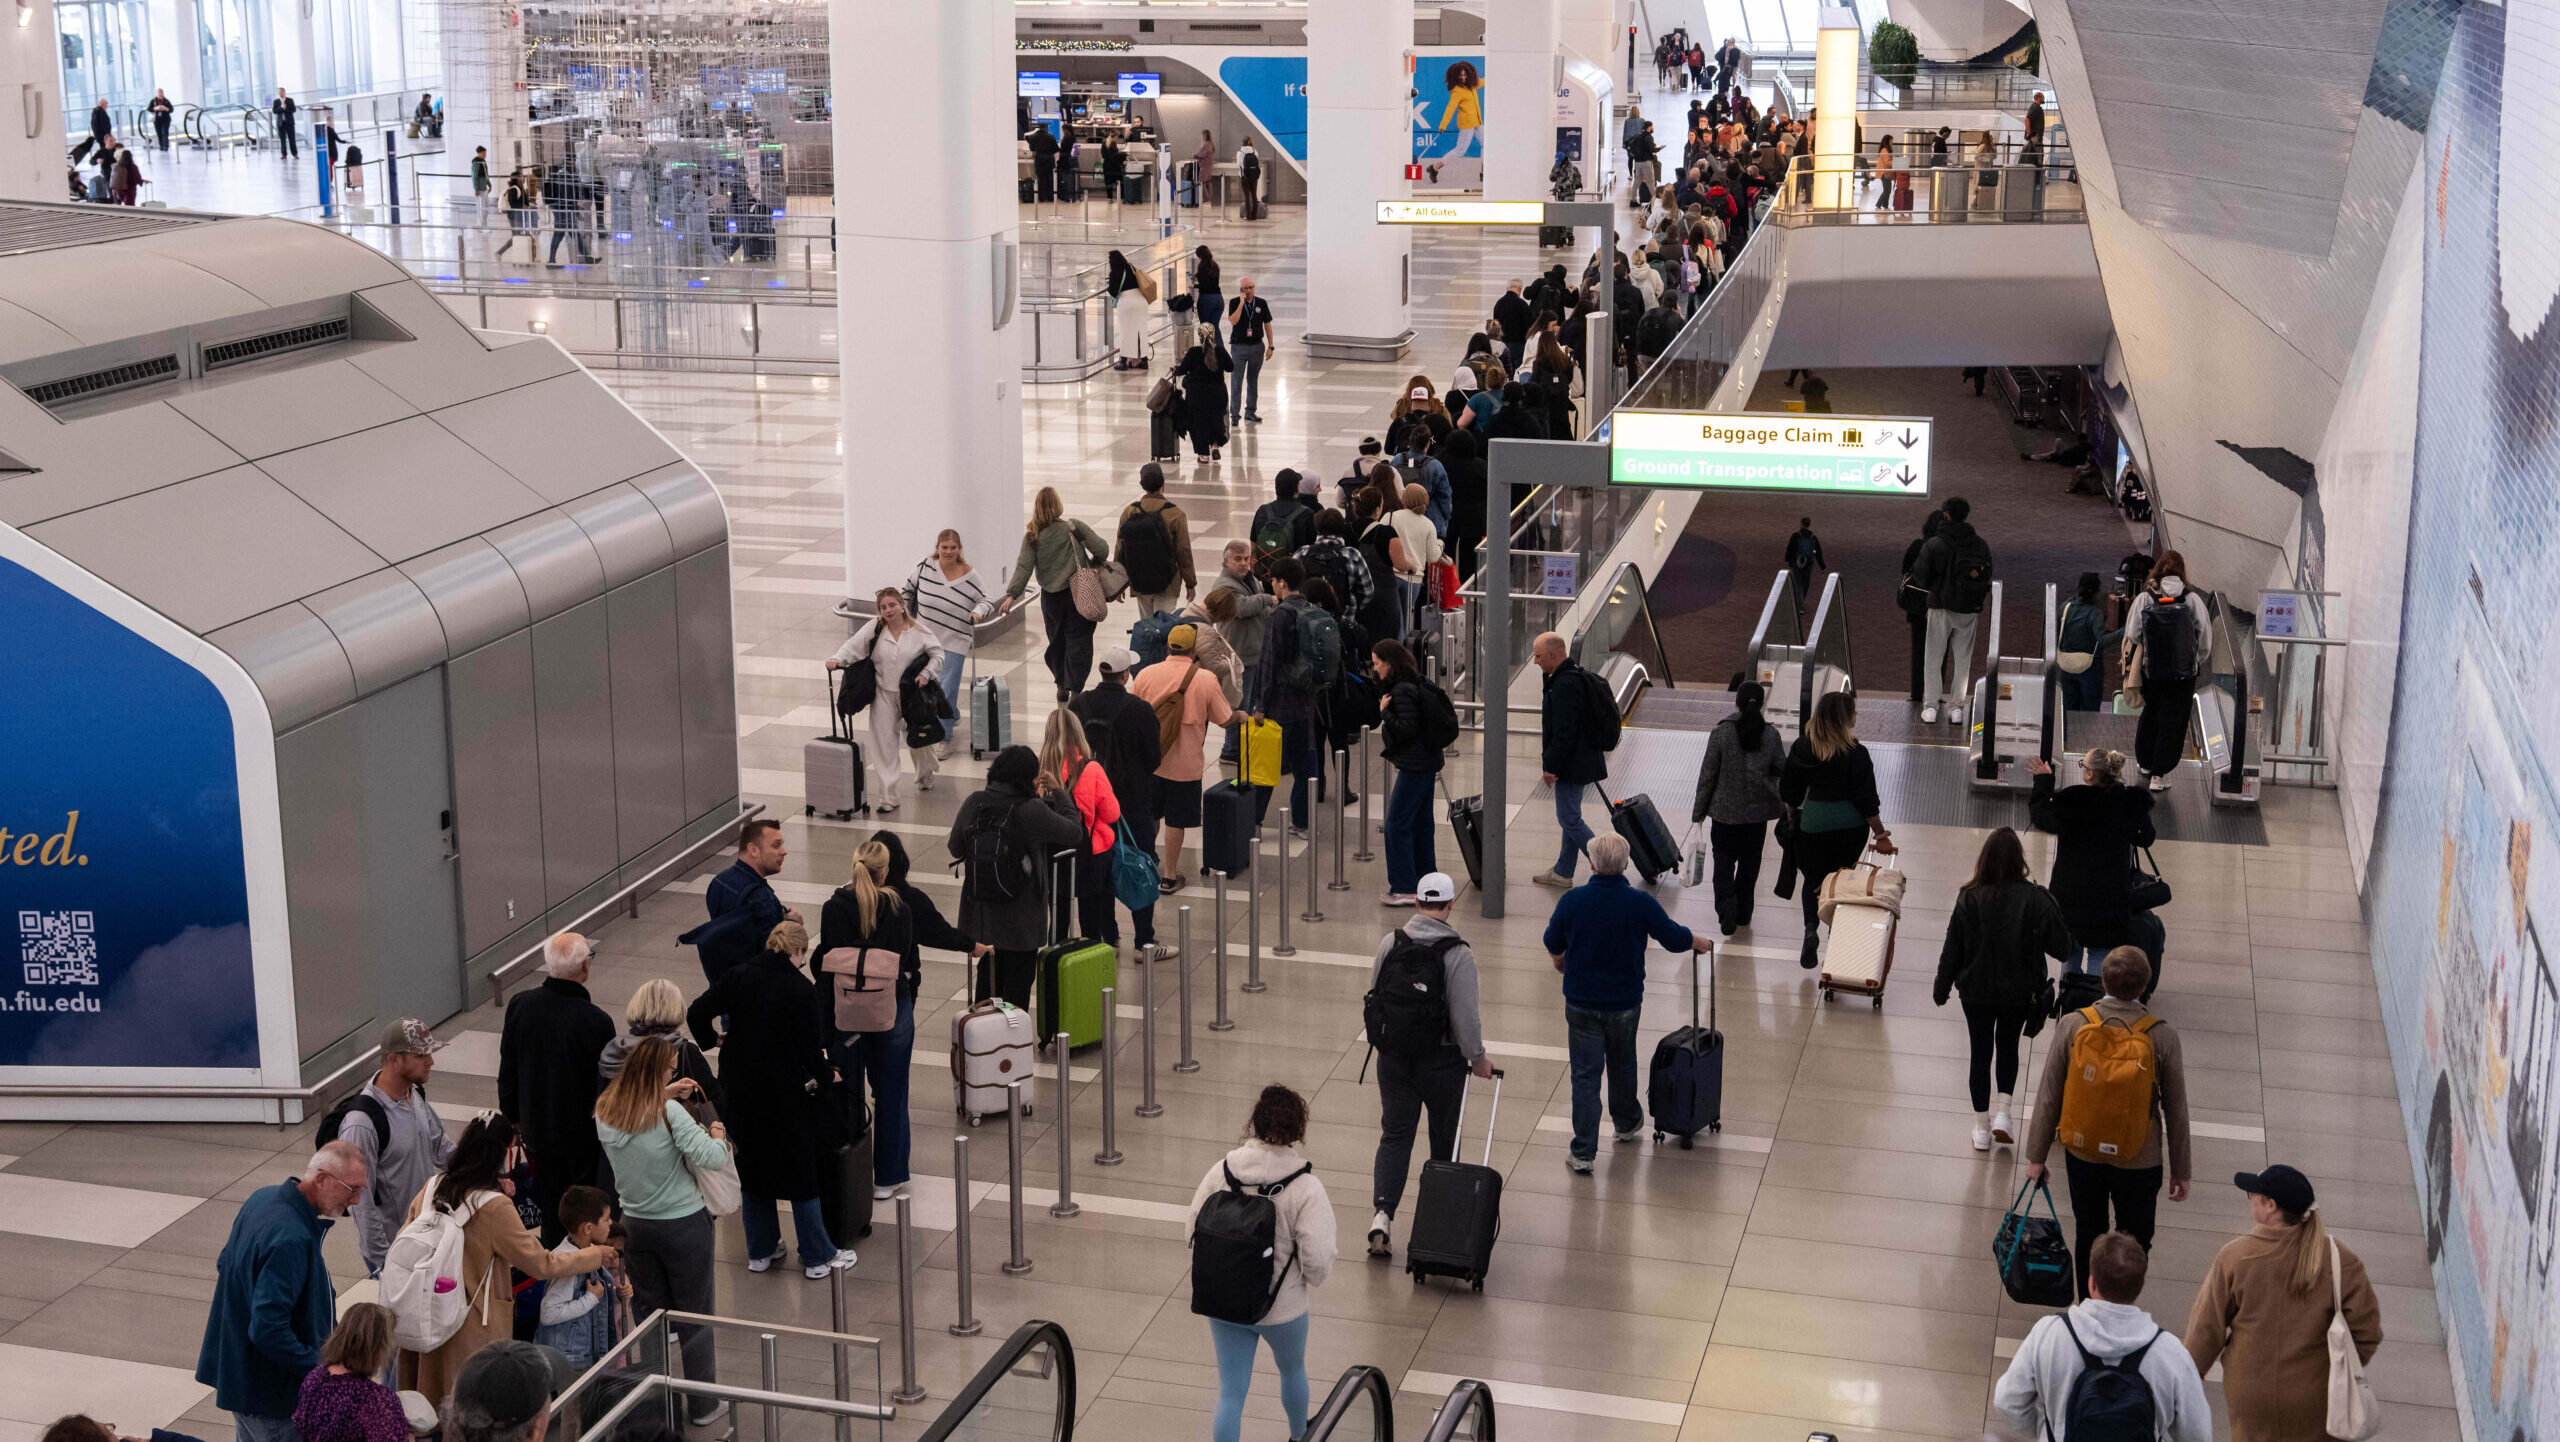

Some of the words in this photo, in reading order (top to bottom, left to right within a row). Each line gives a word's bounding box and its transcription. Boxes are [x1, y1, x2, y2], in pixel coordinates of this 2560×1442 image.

[1284, 83, 1296, 97] If
[1415, 207, 1428, 217] All
[1431, 207, 1457, 217] Gates
[1702, 424, 1778, 445] Baggage
[1784, 427, 1833, 444] Claim
[1623, 457, 1690, 476] Ground
[1697, 460, 1833, 481] Transportation
